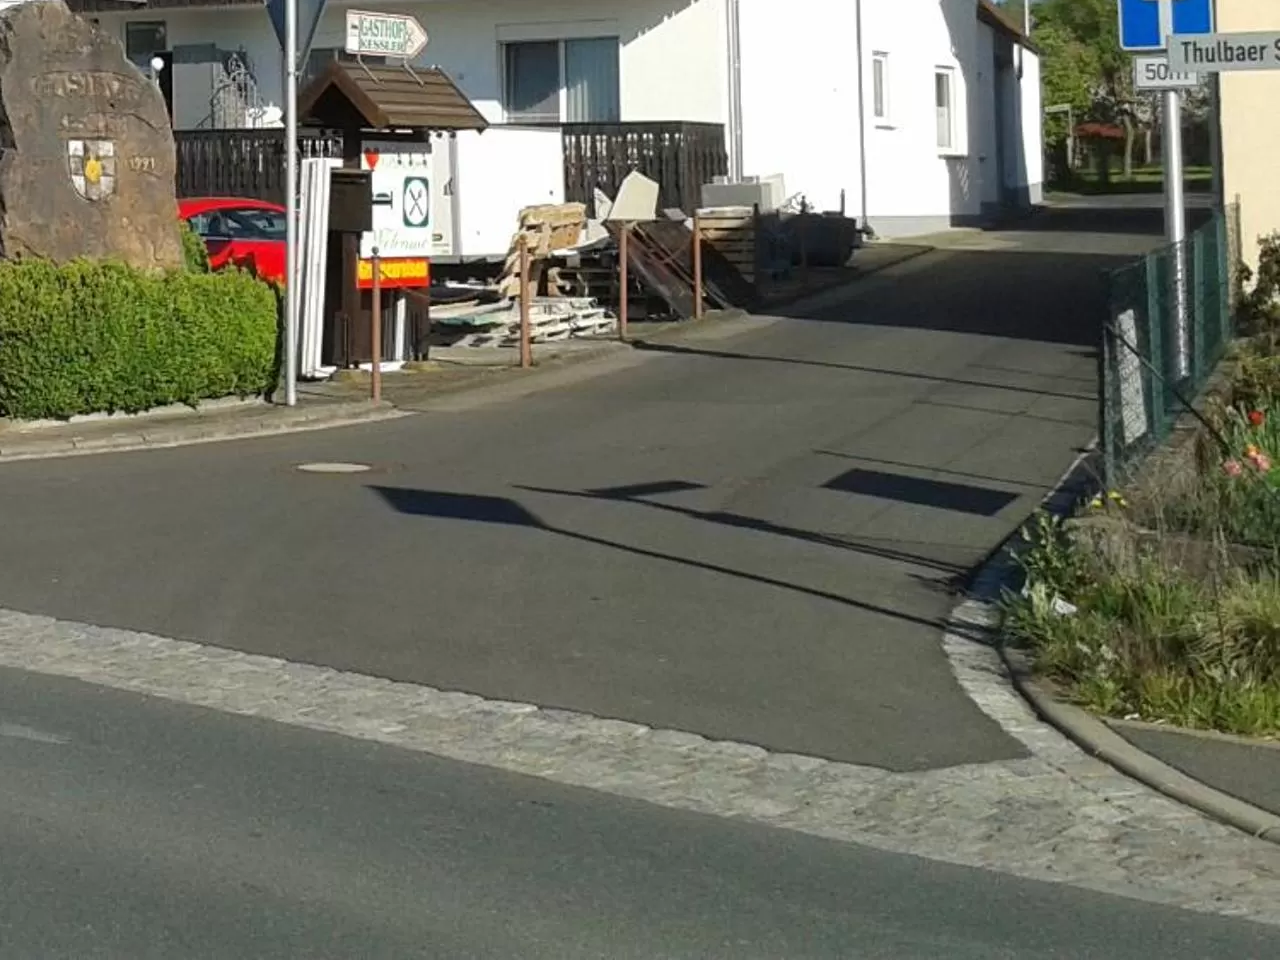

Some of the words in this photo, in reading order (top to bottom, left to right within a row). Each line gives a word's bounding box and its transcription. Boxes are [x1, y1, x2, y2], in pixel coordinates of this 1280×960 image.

[360, 17, 407, 40] GASTHOF
[360, 39, 405, 52] KESSLER
[1181, 40, 1268, 64] Thulbaer
